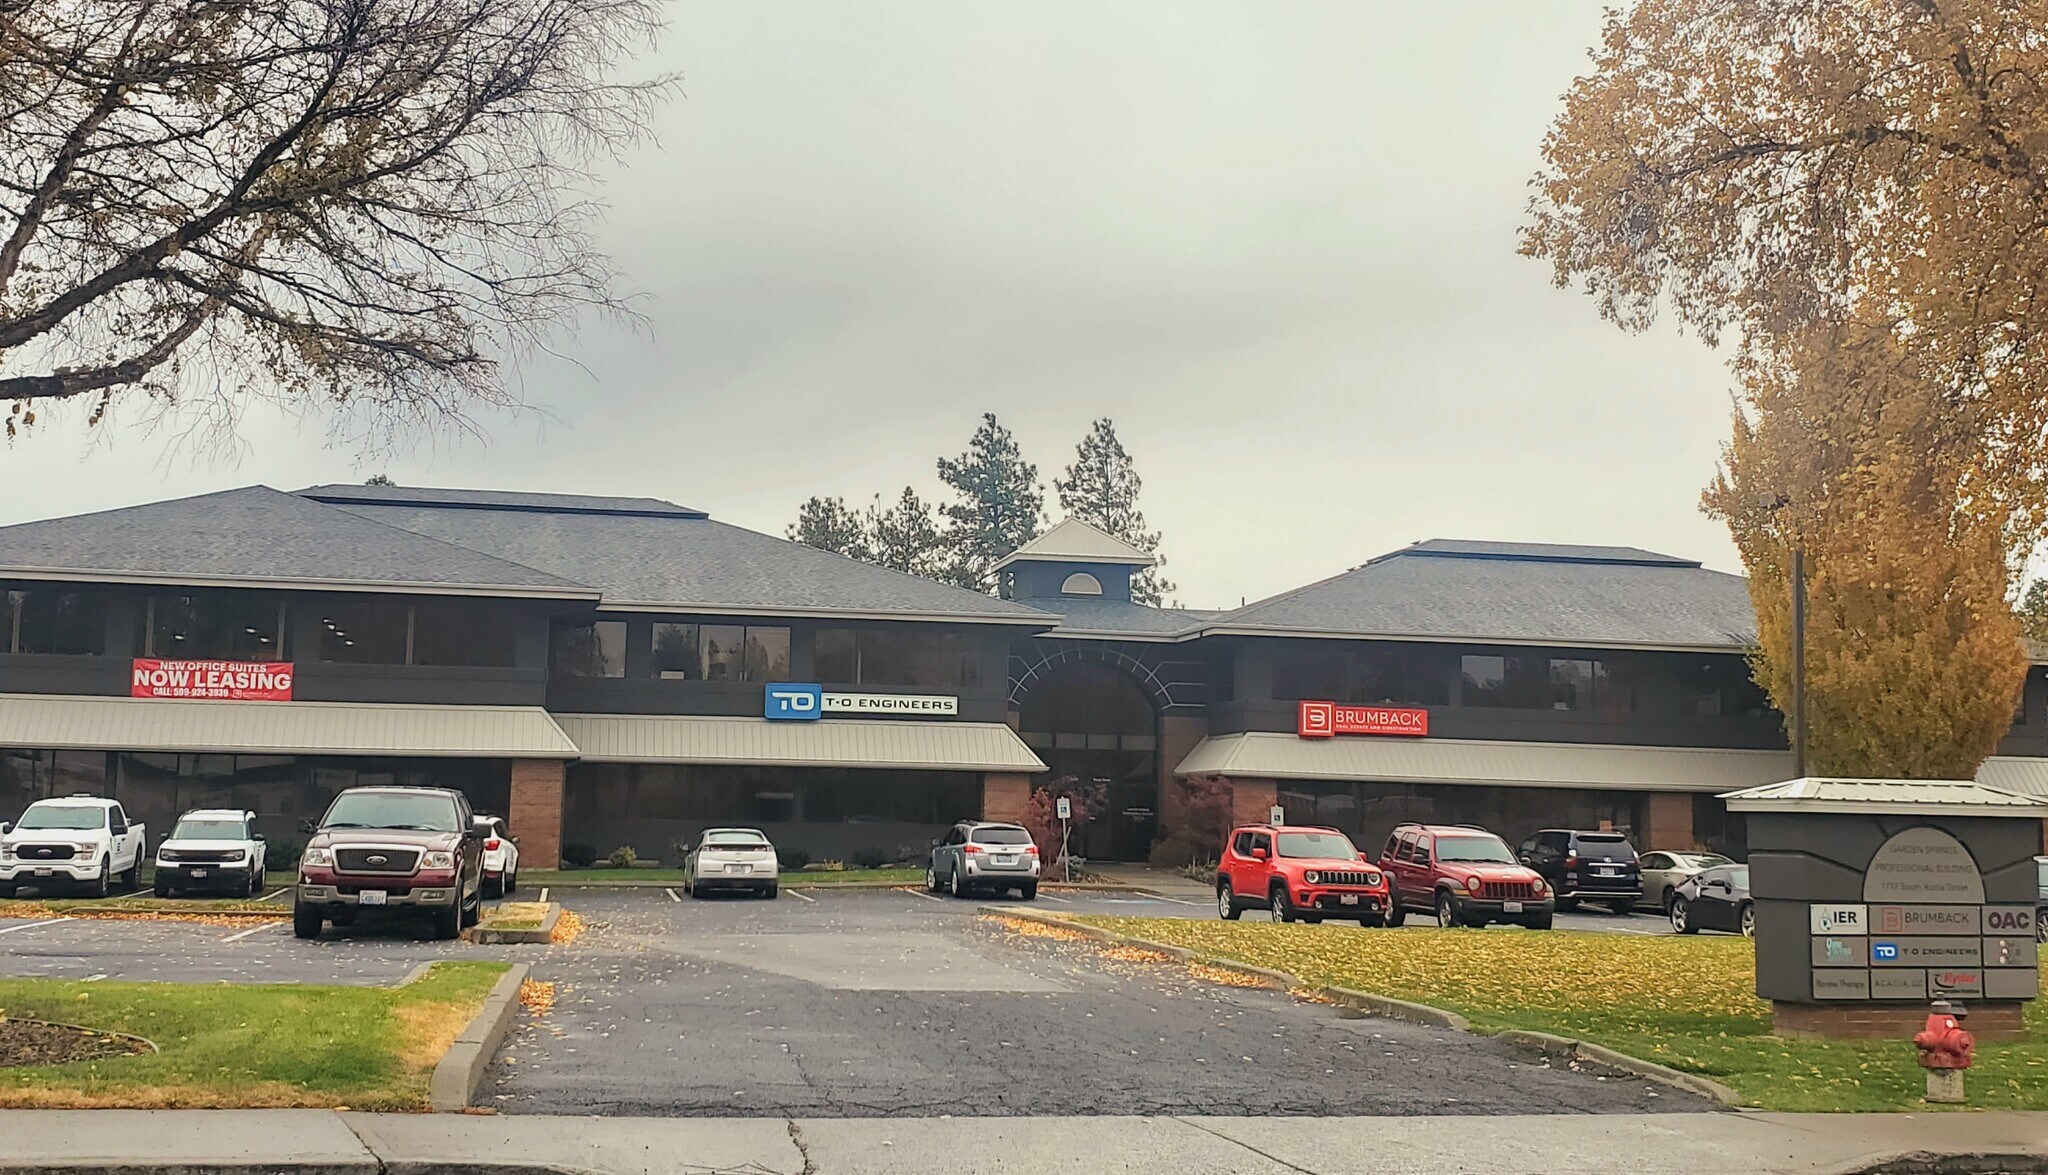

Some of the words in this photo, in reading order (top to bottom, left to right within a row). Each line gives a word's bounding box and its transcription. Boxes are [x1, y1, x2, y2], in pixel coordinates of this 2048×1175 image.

[160, 662, 185, 670] NEW
[188, 662, 228, 672] OFFICE
[228, 664, 267, 672] SUITES
[134, 670, 190, 687] NOW
[195, 672, 292, 690] LEASING
[153, 687, 172, 696] CALL:
[859, 699, 953, 710] ENGINEERS
[1336, 710, 1422, 726] BRUMBACK
[1890, 844, 1923, 854] GARDEN
[1875, 863, 1934, 872] PROFESSIONAL
[1936, 865, 1972, 873] BUILDING
[1834, 911, 1857, 924] IER
[1905, 912, 1969, 924] BRUMBACK
[1988, 912, 2030, 929] OAC
